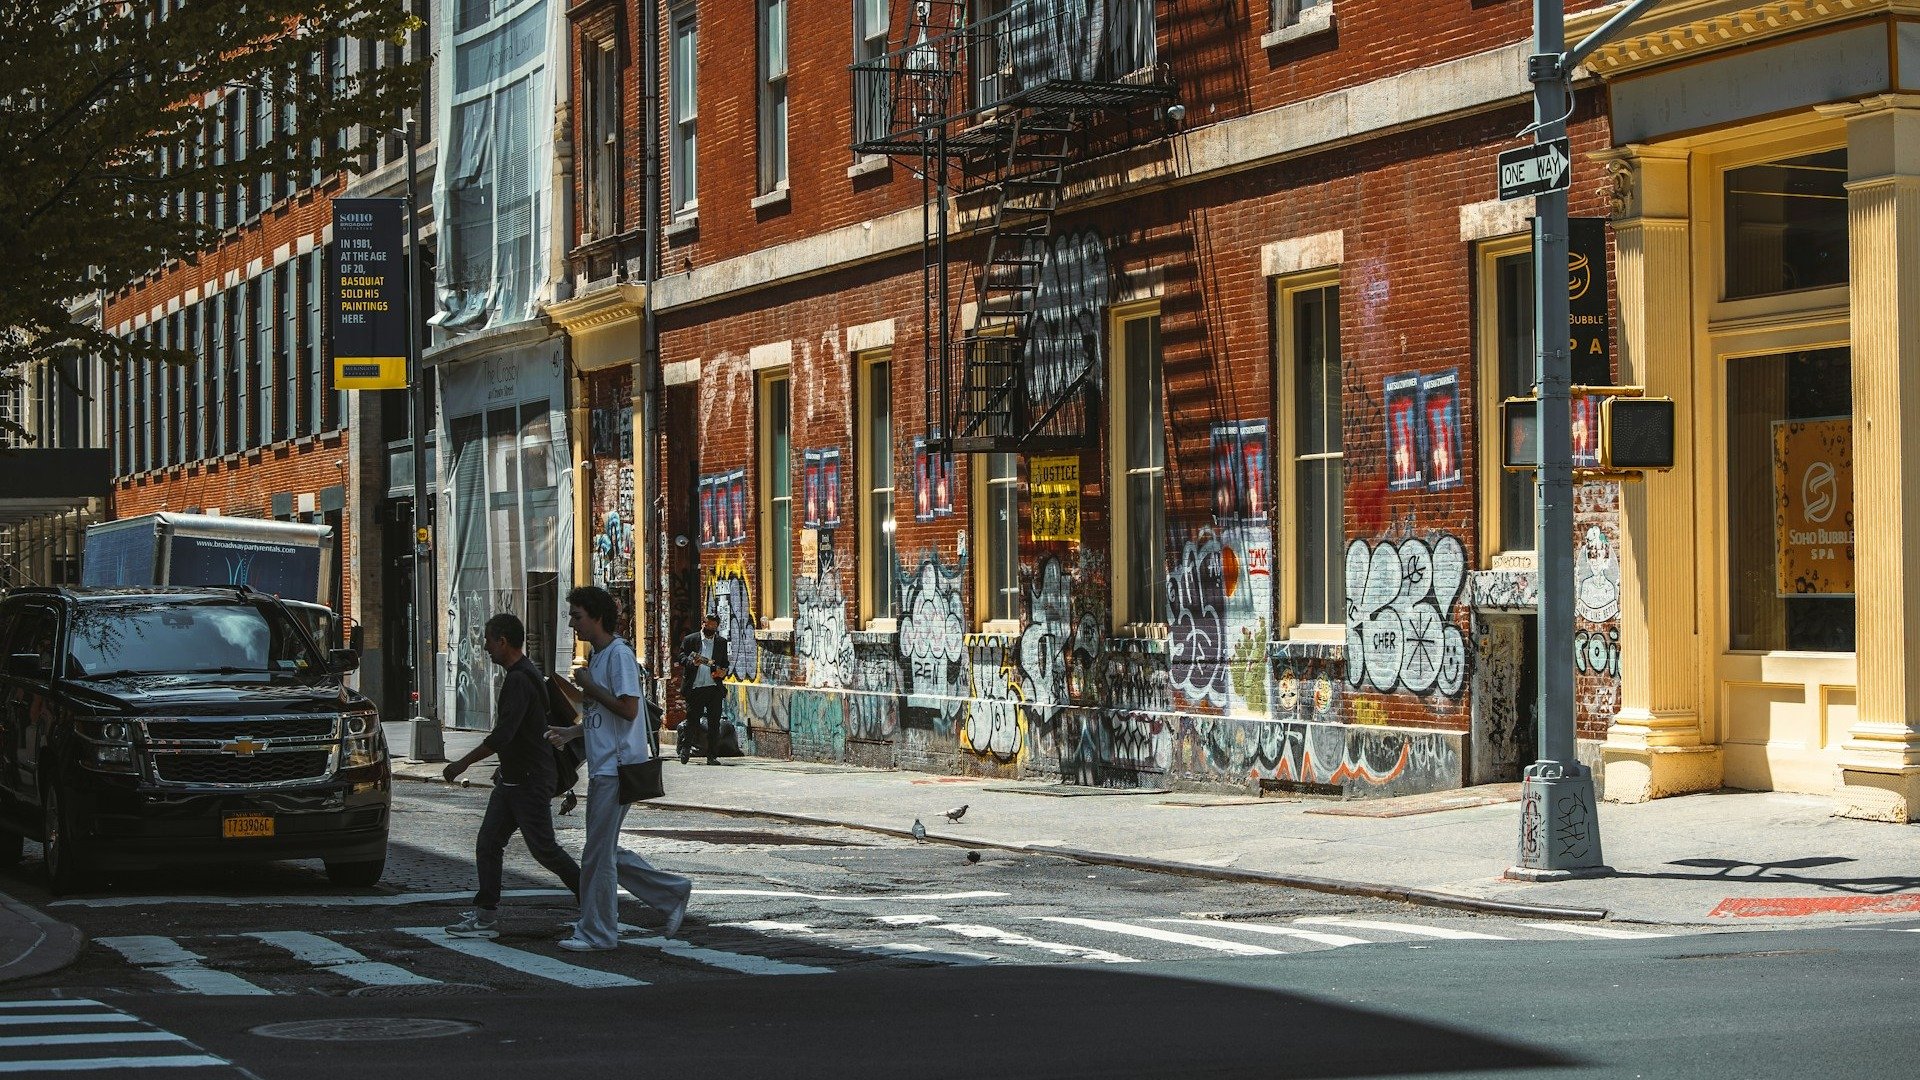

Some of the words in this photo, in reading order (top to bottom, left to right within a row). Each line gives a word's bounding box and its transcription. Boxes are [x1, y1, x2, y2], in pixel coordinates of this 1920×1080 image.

[1504, 163, 1525, 185] ONE
[1537, 156, 1558, 178] WAY
[340, 238, 351, 249] IN
[352, 238, 373, 250] 1981,
[340, 251, 351, 261] AT
[352, 251, 369, 261] THE
[369, 251, 387, 261] AGE
[340, 264, 352, 274] OF
[353, 264, 366, 275] 20,
[340, 276, 385, 287] BASQUIAT
[341, 289, 363, 299] SOLD
[364, 289, 380, 299] HIS
[341, 301, 389, 312] PAINTINGS
[341, 314, 367, 324] HERE.
[1569, 313, 1604, 325] BUBBLE
[1035, 465, 1077, 487] JUSTICE
[196, 540, 296, 553] www.broadwaypartyrentals.com
[1810, 548, 1835, 560] SPA
[1373, 631, 1397, 651] CHER
[228, 819, 269, 832] T733906C
